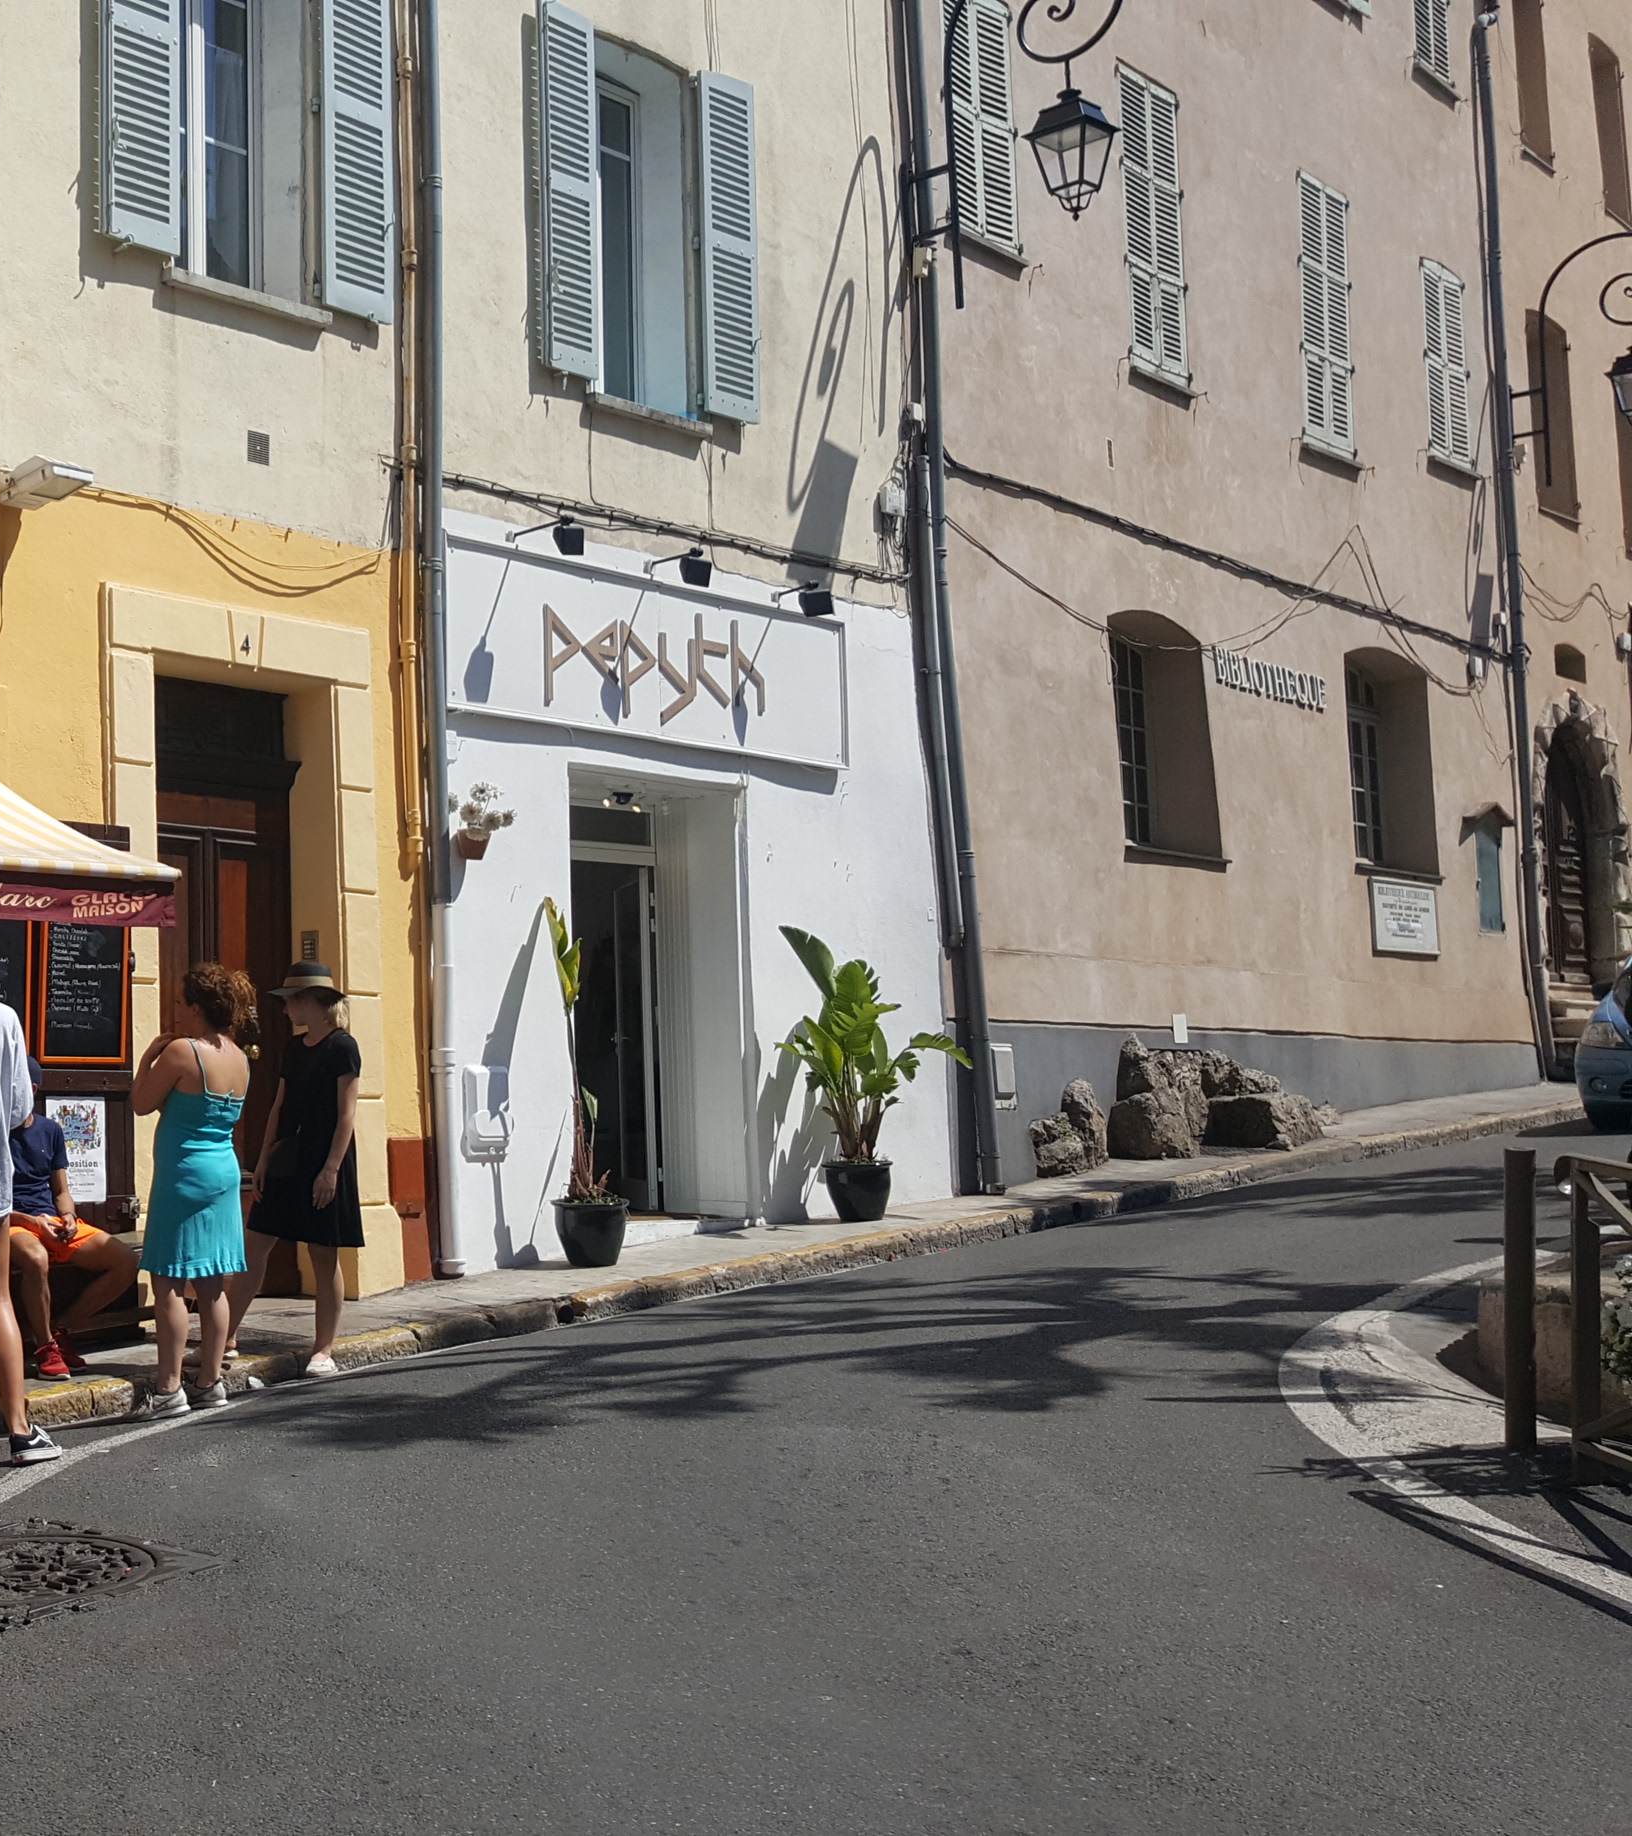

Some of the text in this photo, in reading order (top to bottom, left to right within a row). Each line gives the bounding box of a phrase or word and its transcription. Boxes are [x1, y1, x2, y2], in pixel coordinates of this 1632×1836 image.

[1214, 646, 1328, 709] BIBLIOTHEQUE
[72, 900, 144, 918] MAISON
[68, 1159, 99, 1168] osition
